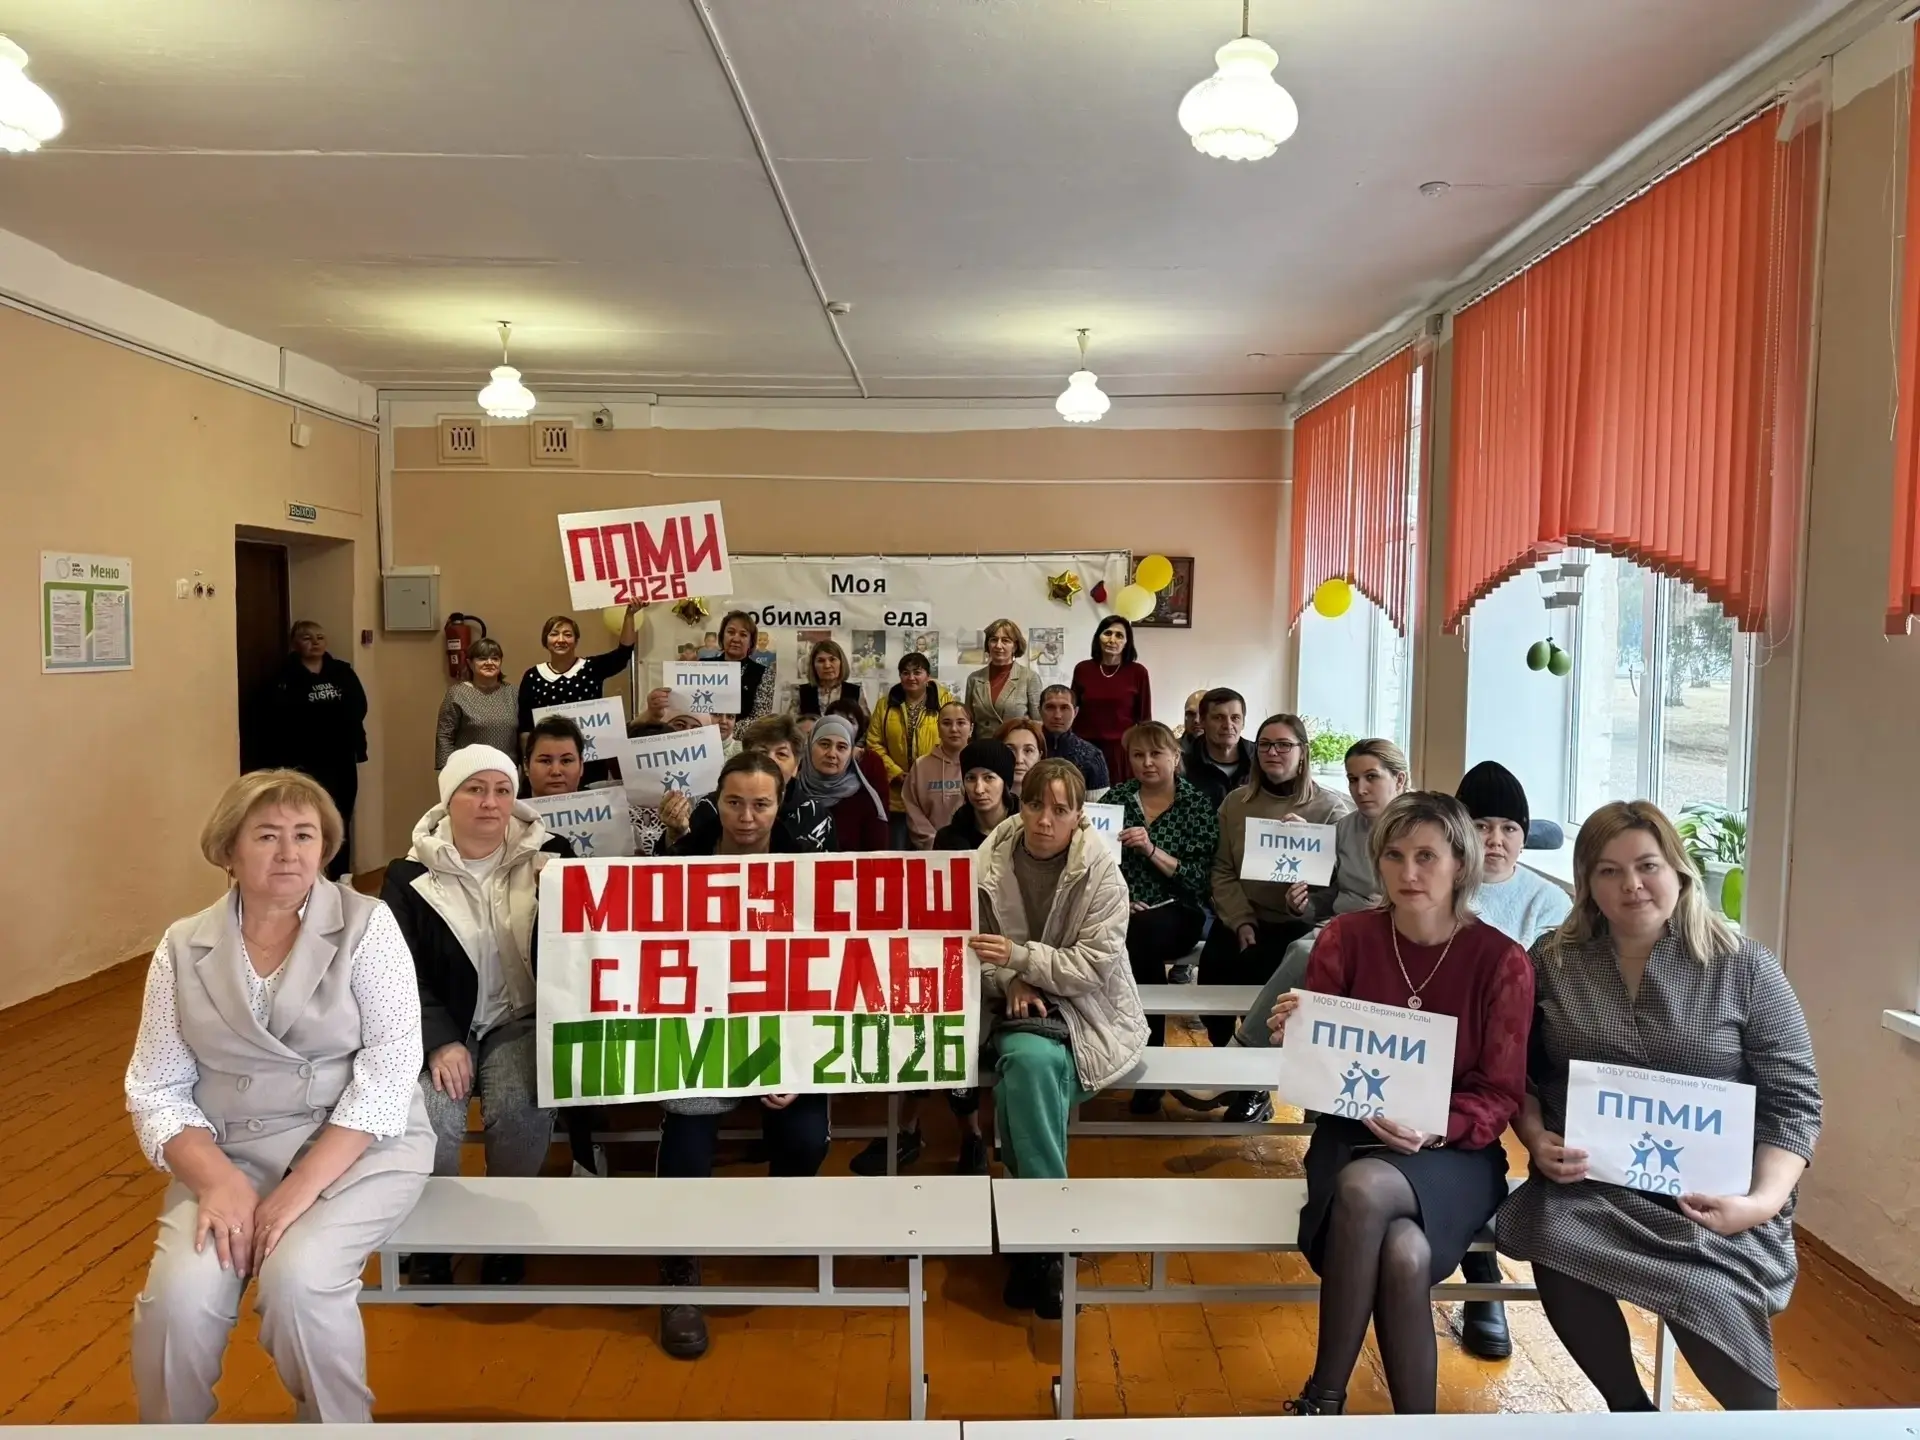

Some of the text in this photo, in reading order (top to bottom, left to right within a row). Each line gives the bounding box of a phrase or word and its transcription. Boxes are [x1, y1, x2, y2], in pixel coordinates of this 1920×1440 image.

[291, 505, 315, 518] ВЫХОД
[567, 514, 722, 582] ППМИ
[90, 564, 120, 579] Меню
[610, 573, 688, 604] 2026
[831, 574, 886, 593] Моя
[884, 611, 928, 627] еда
[676, 674, 728, 685] ППМИ
[690, 705, 714, 713] 2026
[576, 712, 611, 729] МИ
[584, 751, 599, 761] 26
[636, 743, 707, 770] ППМИ
[1260, 833, 1321, 852] ППМИ
[1270, 872, 1298, 883] 2026
[562, 858, 972, 933] МОБУ СОШ
[728, 936, 964, 1013] УСЛЫ
[1312, 995, 1338, 1007] МОБУ
[1340, 1000, 1361, 1011] СОШ
[1408, 1012, 1431, 1023] Услы
[1312, 1020, 1426, 1064] ППМИ
[553, 1014, 967, 1099] ППМИ 2026
[1597, 1066, 1624, 1077] МОБУ
[1627, 1071, 1649, 1081] СОШ
[1597, 1090, 1722, 1135] ППМИ
[1624, 1170, 1682, 1196] 2026
